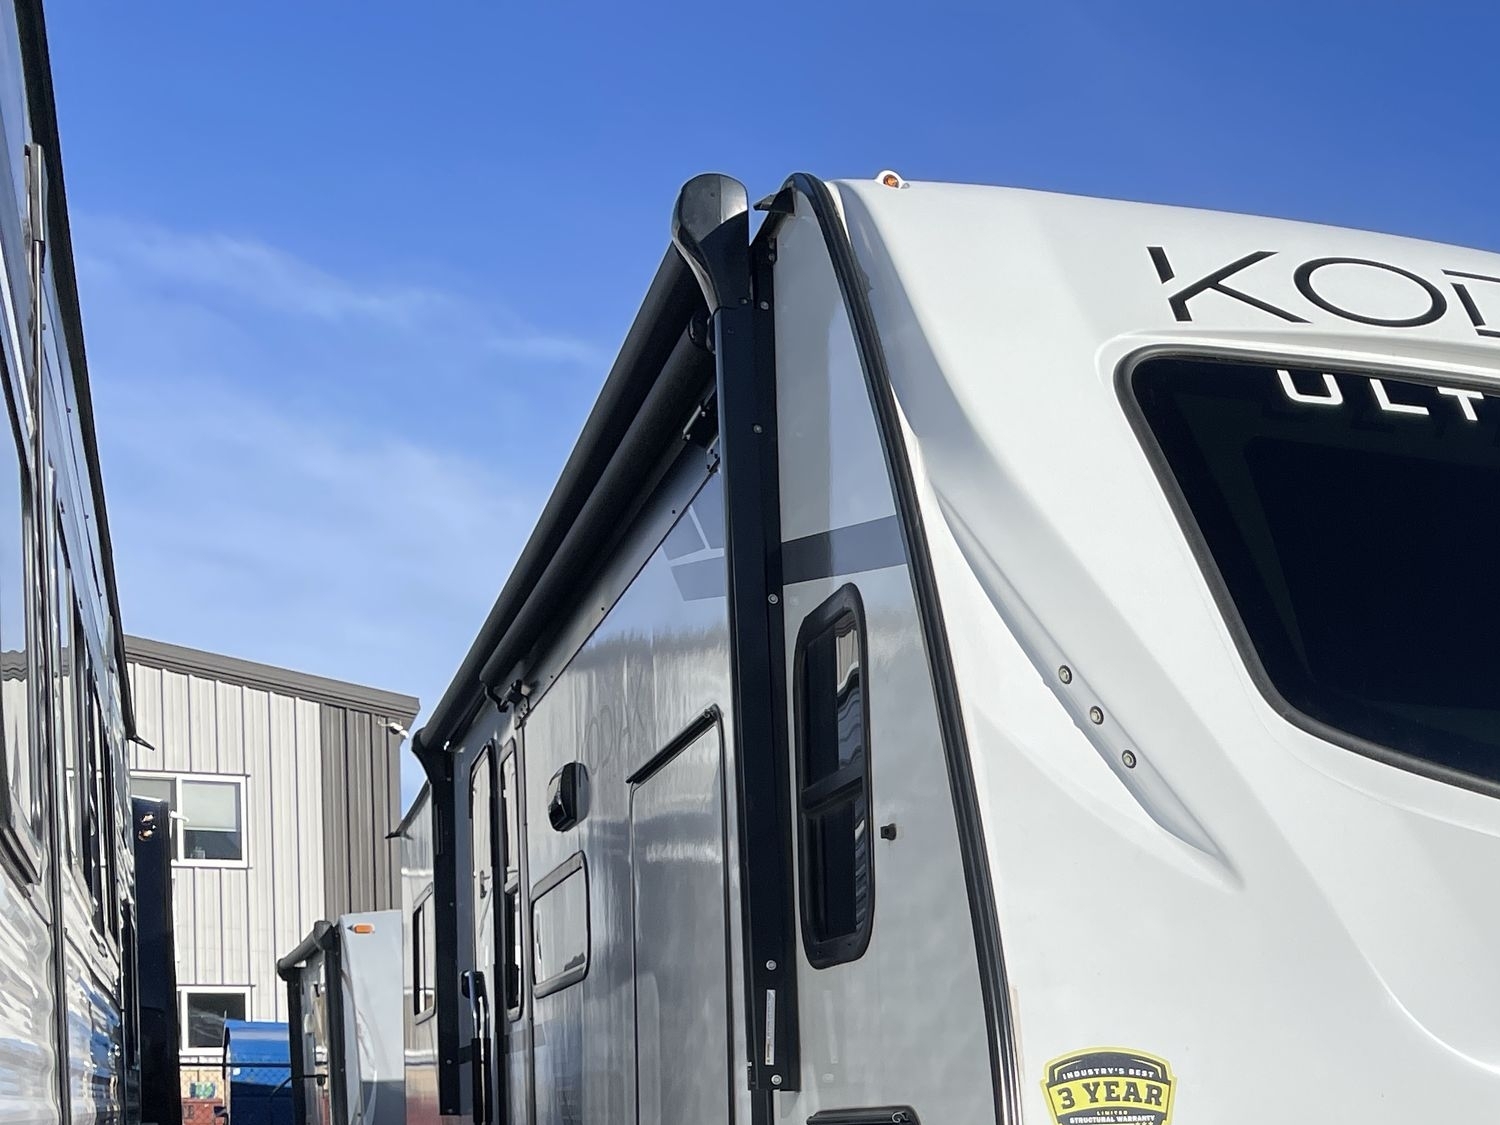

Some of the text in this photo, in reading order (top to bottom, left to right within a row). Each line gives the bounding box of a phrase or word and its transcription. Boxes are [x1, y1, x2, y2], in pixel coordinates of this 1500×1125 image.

[1062, 1068, 1155, 1080] INDUSTRY'S BEST
[1057, 1080, 1163, 1110] 3 YEAR
[1069, 1115, 1155, 1124] STRUCTURAL WARRANTY
